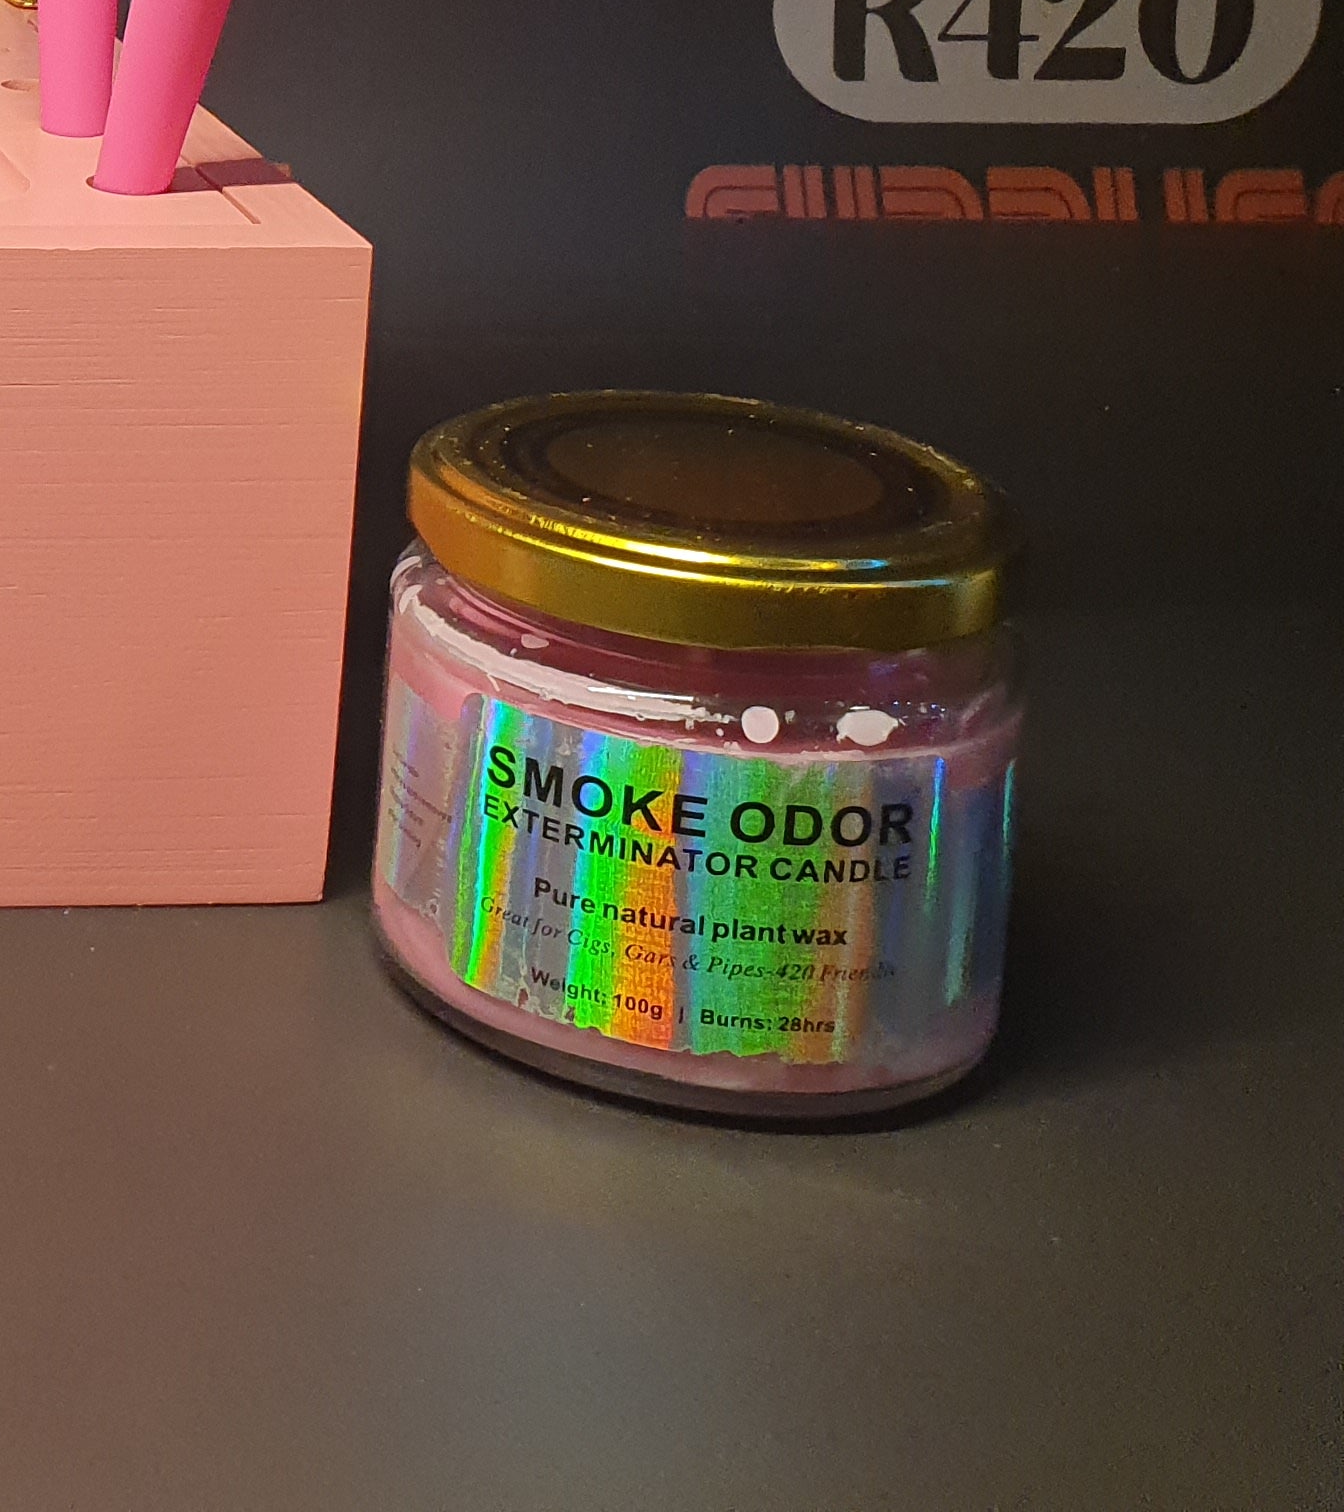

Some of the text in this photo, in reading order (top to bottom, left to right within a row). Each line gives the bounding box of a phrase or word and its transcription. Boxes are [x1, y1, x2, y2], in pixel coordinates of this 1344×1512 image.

[487, 745, 708, 838] SMOKE
[730, 801, 913, 848] ODOR
[483, 793, 758, 879] EXTERMINATOR
[770, 855, 911, 884] CANDLE
[480, 896, 529, 929] Great
[532, 918, 563, 939] for
[682, 953, 700, 971] &
[534, 877, 848, 946] Pure natural plant wax
[531, 966, 836, 1034] Weight: 100g Burns: 28hrs
